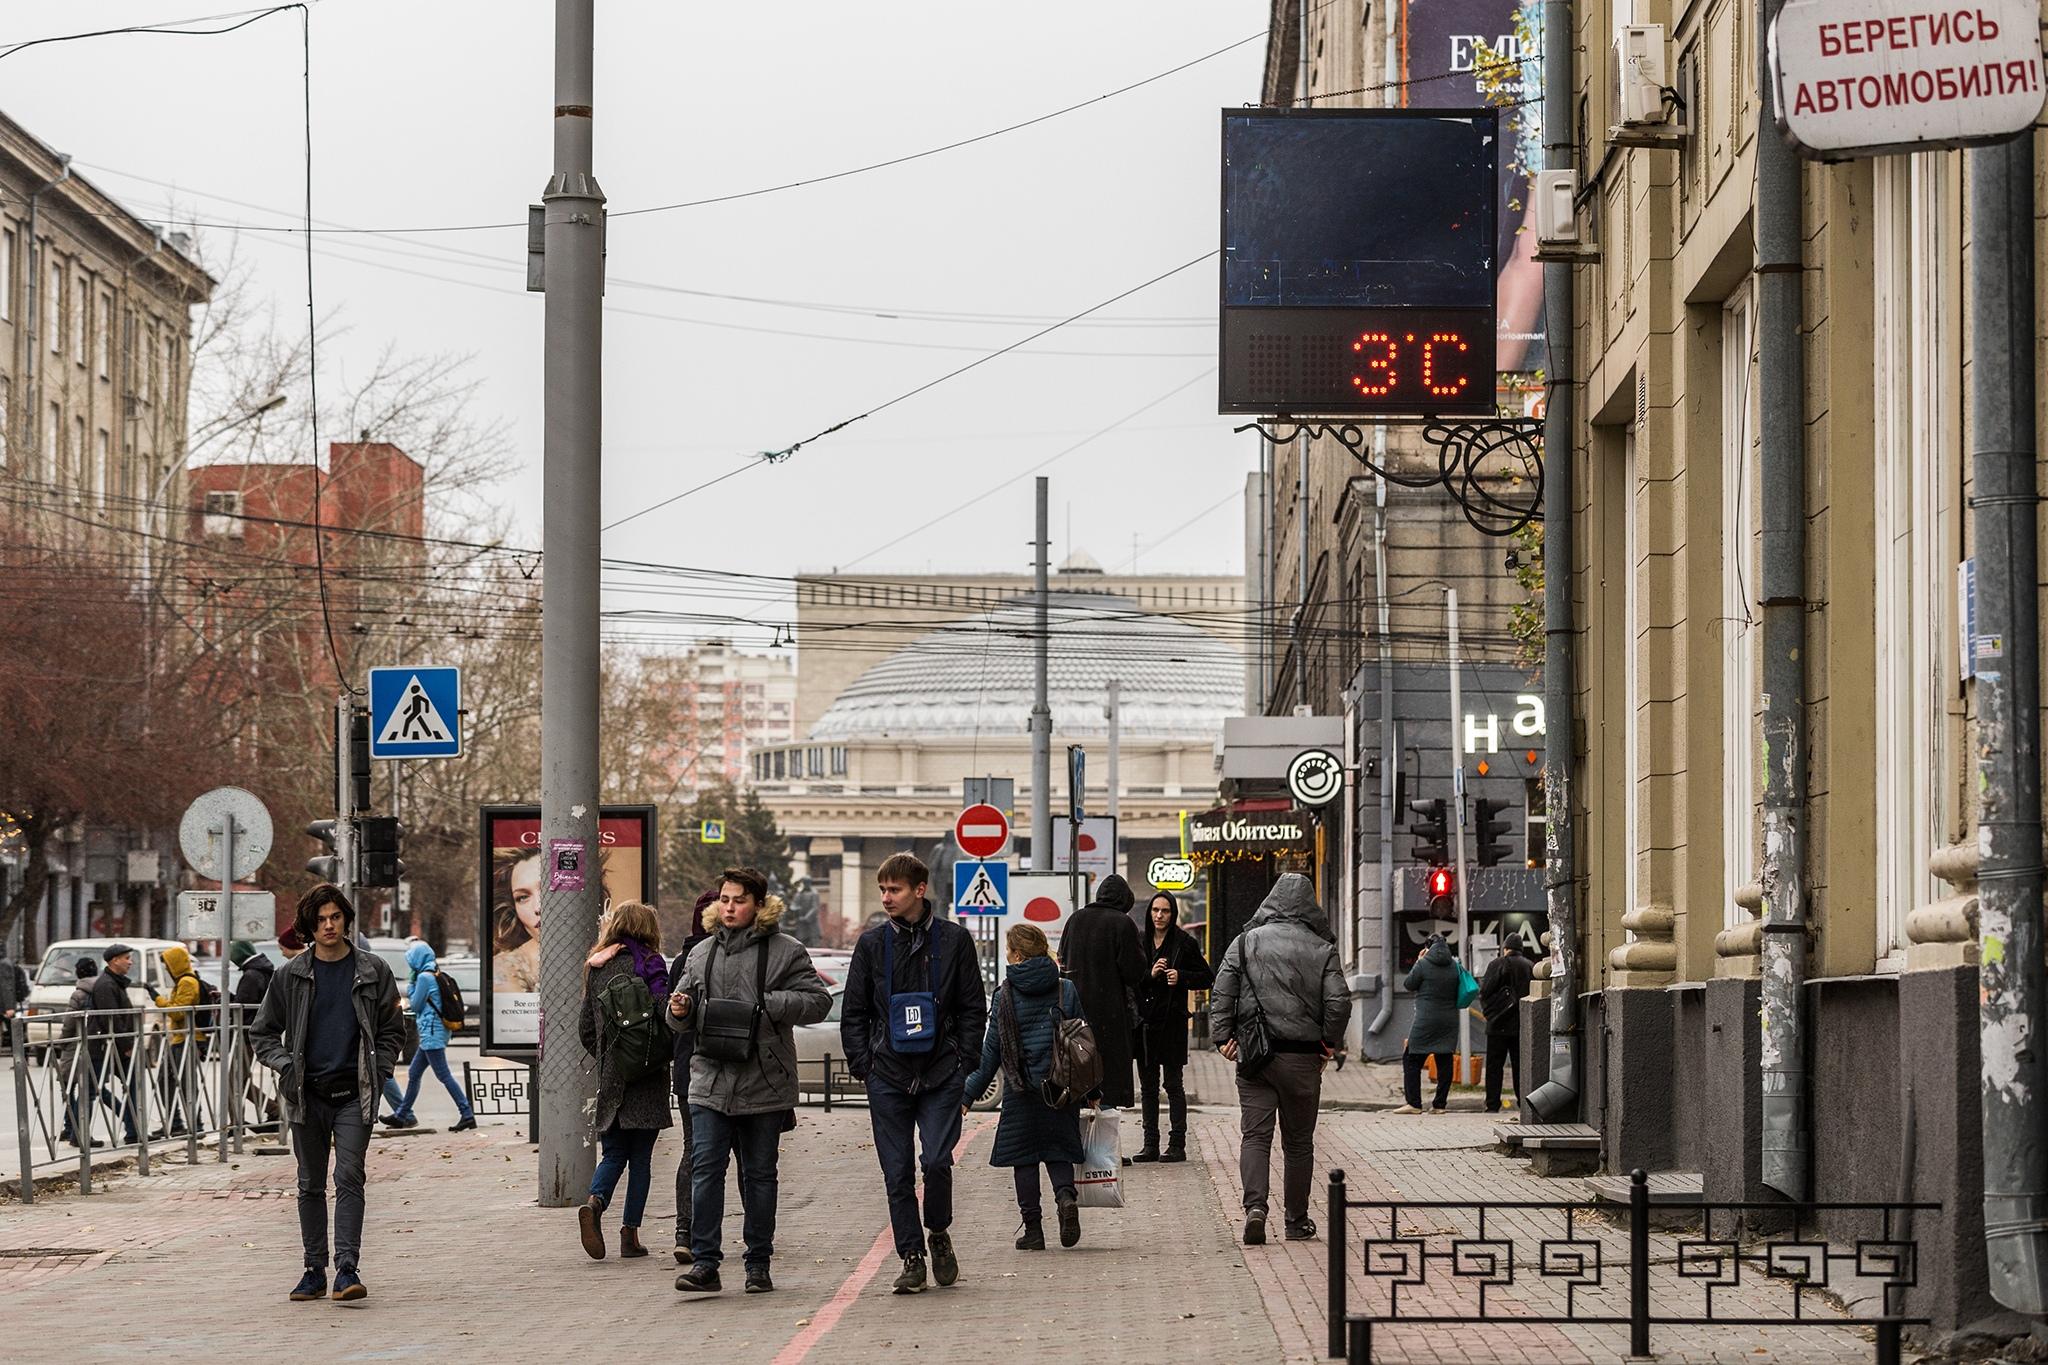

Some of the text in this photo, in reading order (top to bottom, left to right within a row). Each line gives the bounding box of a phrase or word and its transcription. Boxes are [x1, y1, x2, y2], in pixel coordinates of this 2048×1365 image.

[1819, 9, 1999, 57] БЕРЕГИСЬ
[1794, 60, 2038, 116] АВТОМОБИЛЯ!
[1298, 760, 1328, 778] COFFEE
[1222, 818, 1303, 842] Обитель
